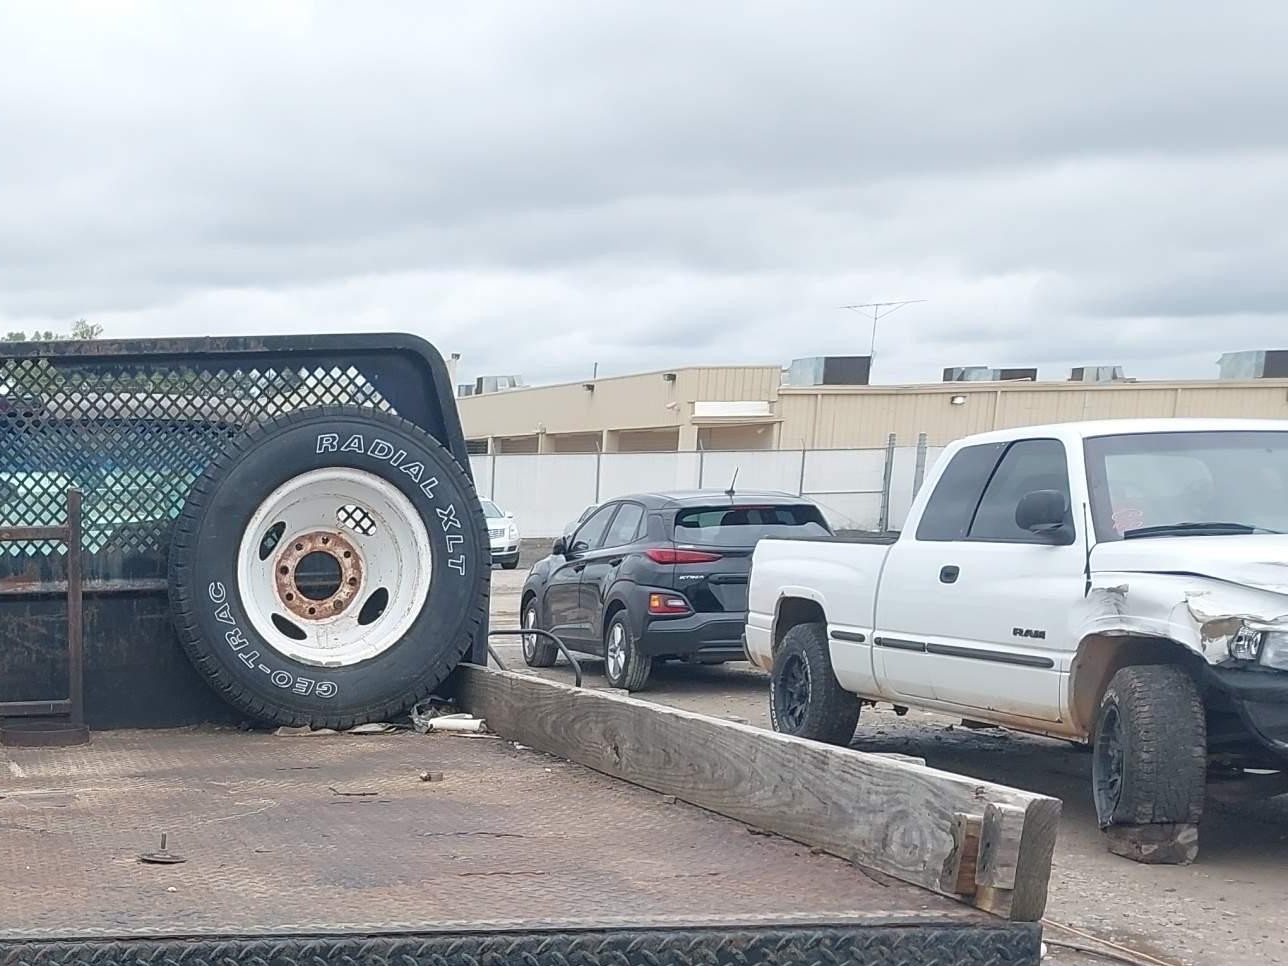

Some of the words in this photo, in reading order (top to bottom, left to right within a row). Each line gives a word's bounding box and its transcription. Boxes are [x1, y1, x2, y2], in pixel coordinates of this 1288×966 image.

[315, 433, 440, 499] RADIAL
[435, 503, 466, 576] XLT
[208, 581, 338, 698] GEO-TRAC
[1012, 627, 1047, 640] RAM
